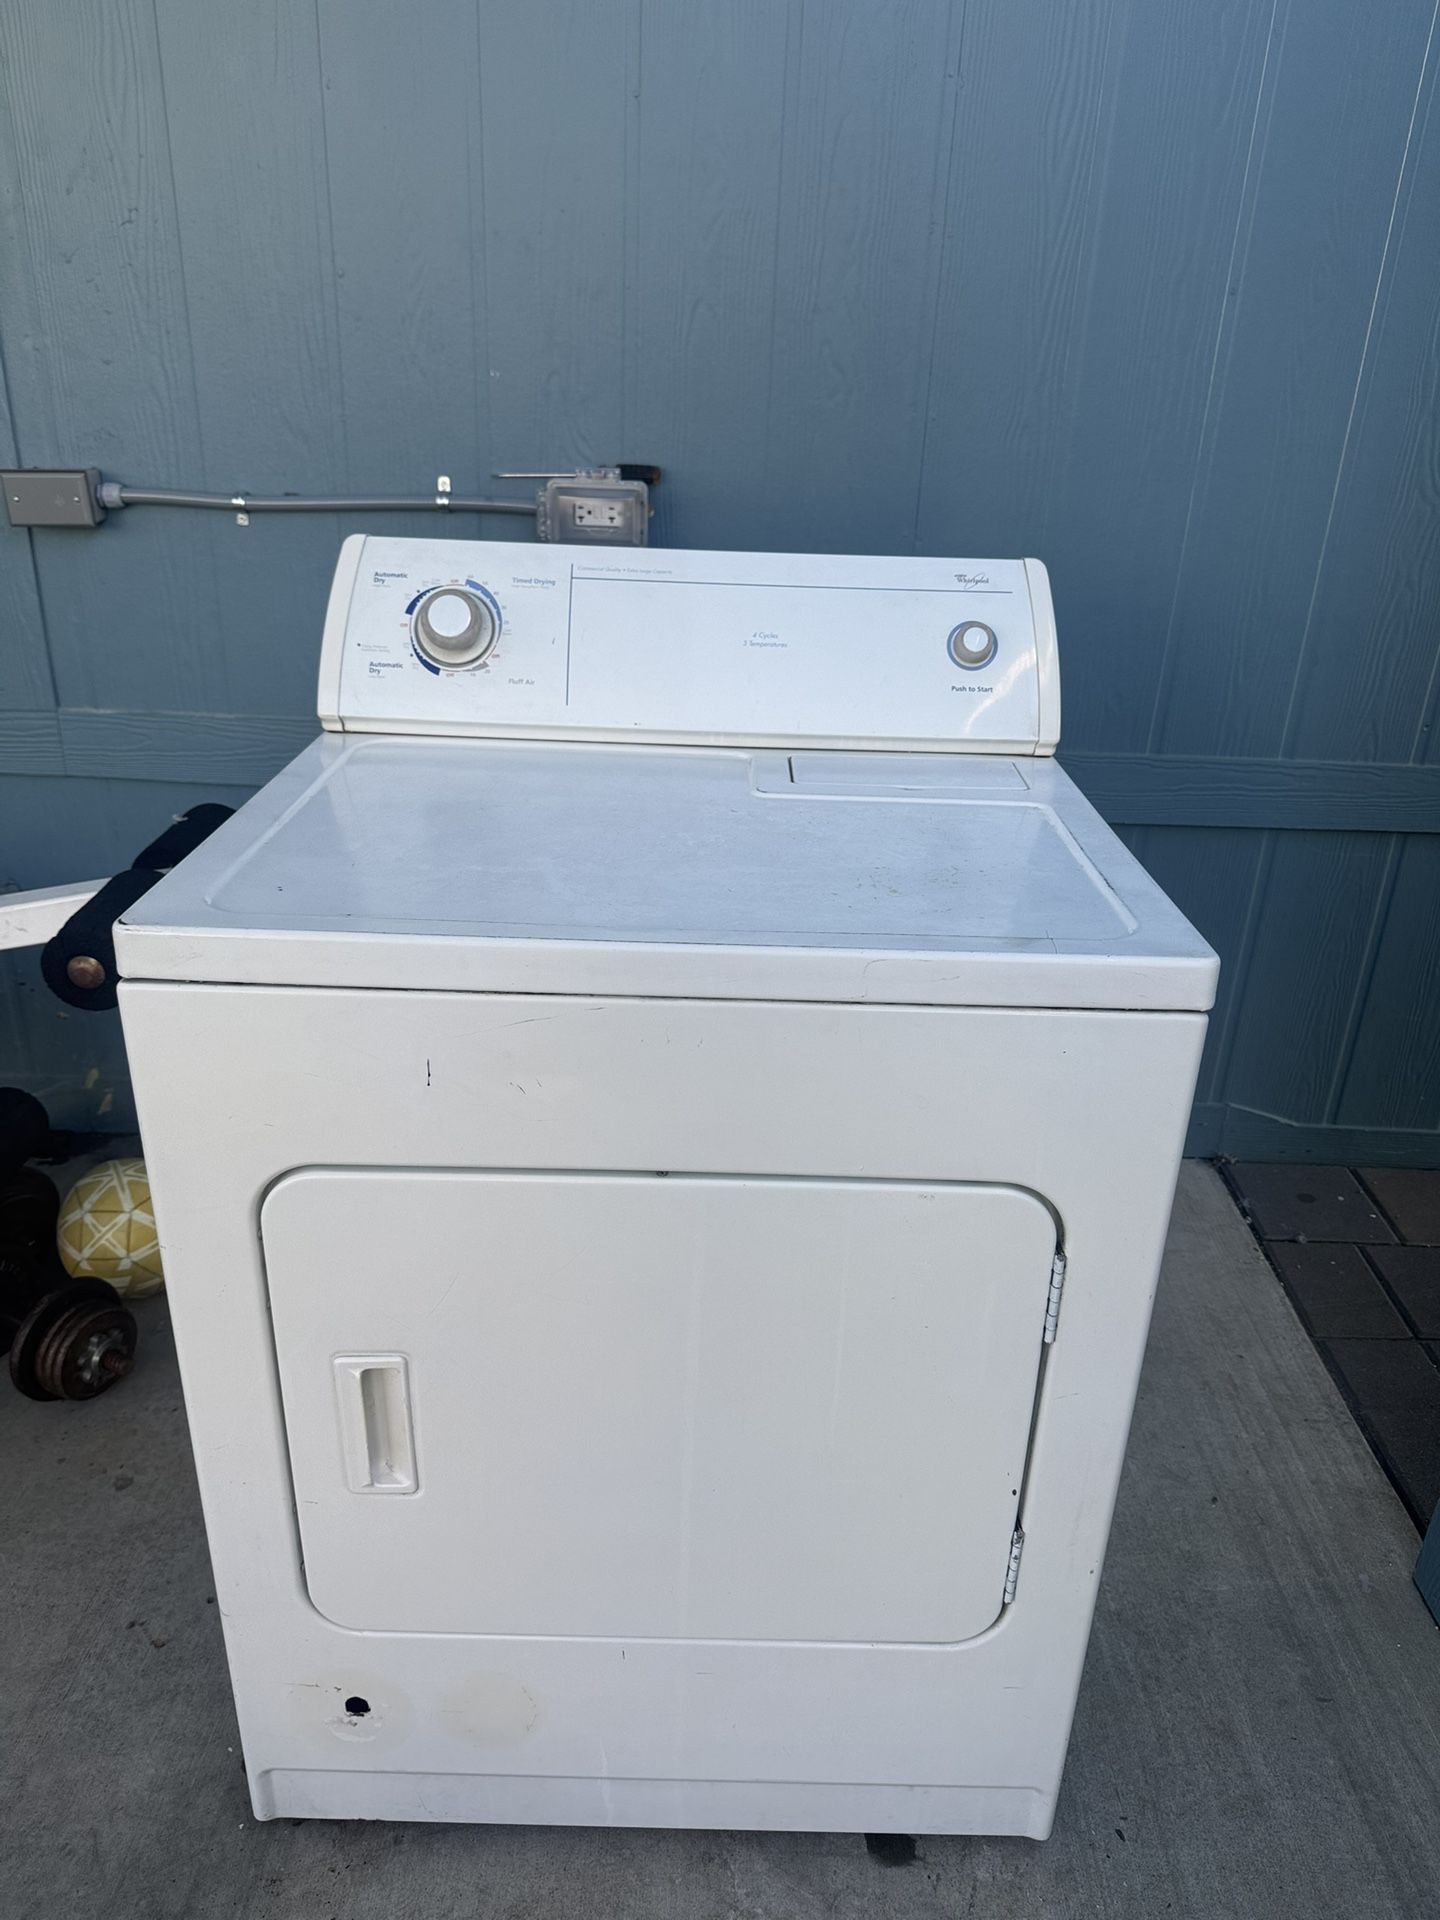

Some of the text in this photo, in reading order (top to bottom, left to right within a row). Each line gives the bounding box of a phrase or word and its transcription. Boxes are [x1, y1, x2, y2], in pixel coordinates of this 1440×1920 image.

[374, 571, 408, 579] Automatic
[534, 578, 556, 586] Drying
[759, 632, 778, 640] Cycles
[369, 661, 403, 669] Automatic
[368, 667, 381, 675] Dry
[951, 685, 967, 693] Push
